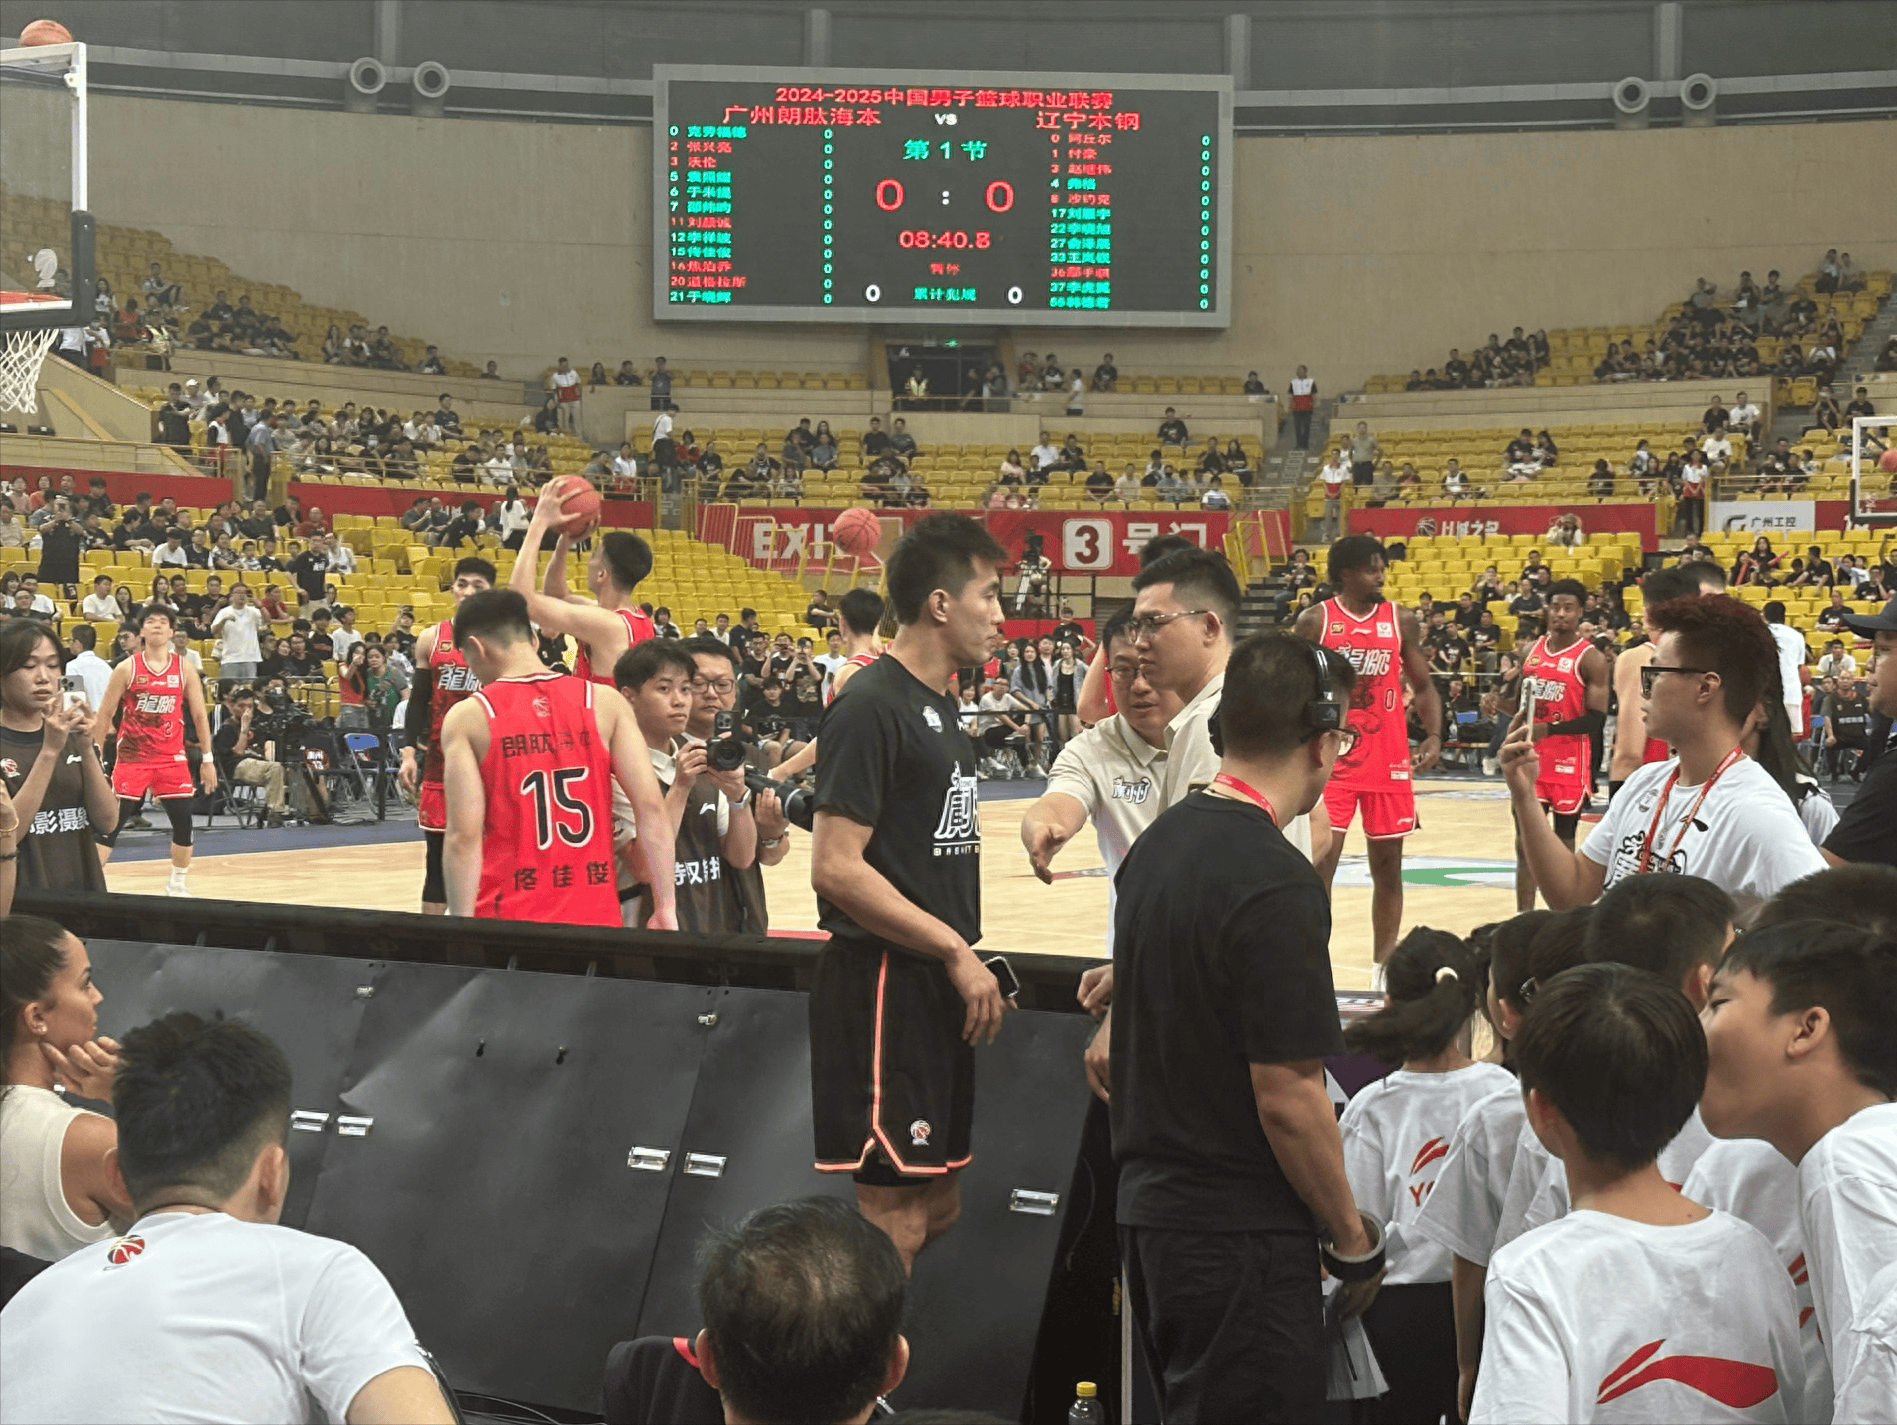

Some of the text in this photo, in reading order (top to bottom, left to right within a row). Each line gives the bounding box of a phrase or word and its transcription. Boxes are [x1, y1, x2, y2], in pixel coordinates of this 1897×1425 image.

[775, 87, 1113, 109] 2024-2025中国男子篮球职业联赛
[722, 105, 881, 126] 广州朗肽海本
[1036, 110, 1140, 131] 辽宁本钢
[670, 126, 679, 136] 0
[824, 129, 833, 139] 0
[1051, 133, 1060, 143] 0
[1202, 135, 1210, 146] 0
[670, 141, 678, 151] 2
[824, 144, 833, 154] 0
[903, 139, 987, 161] 第 1 节
[1052, 149, 1058, 158] 1
[1202, 150, 1210, 161] 0
[670, 156, 678, 166] 3
[824, 159, 833, 169] 0
[1051, 163, 1060, 173] 3
[1202, 165, 1210, 176] 0
[670, 171, 678, 181] 5
[824, 174, 833, 184] 0
[1050, 178, 1059, 188] 4
[1202, 180, 1210, 191] 0
[670, 186, 679, 196] 6
[824, 189, 832, 199] 0
[876, 178, 904, 212] 0
[985, 180, 1014, 213] 0
[1202, 195, 1209, 206] 0
[670, 201, 678, 211] 7
[824, 204, 833, 214] 0
[1051, 208, 1066, 218] 17
[1201, 210, 1209, 221] 0
[824, 219, 832, 229] 0
[1051, 223, 1066, 234] 22
[1201, 225, 1209, 235] 0
[671, 232, 685, 242] 12
[824, 234, 832, 245] 0
[899, 230, 990, 248] 08:40.8
[1051, 238, 1066, 248] 27
[1201, 240, 1209, 250] 0
[671, 247, 685, 256] 15
[824, 249, 832, 259] 0
[1050, 252, 1066, 262] 33
[1201, 254, 1209, 264] 0
[824, 263, 832, 273] 0
[1200, 269, 1209, 279] 0
[671, 275, 685, 287] 20
[824, 279, 832, 289] 0
[866, 284, 880, 302] 0
[1008, 286, 1022, 304] 0
[1200, 284, 1208, 294] 0
[670, 291, 684, 301] 21
[824, 293, 832, 303] 0
[1200, 298, 1208, 309] 0
[1750, 516, 1796, 528] 广州工控
[753, 522, 845, 559] EXI
[1074, 524, 1100, 564] 3
[1384, 688, 1396, 711] 0
[520, 766, 594, 850] 15
